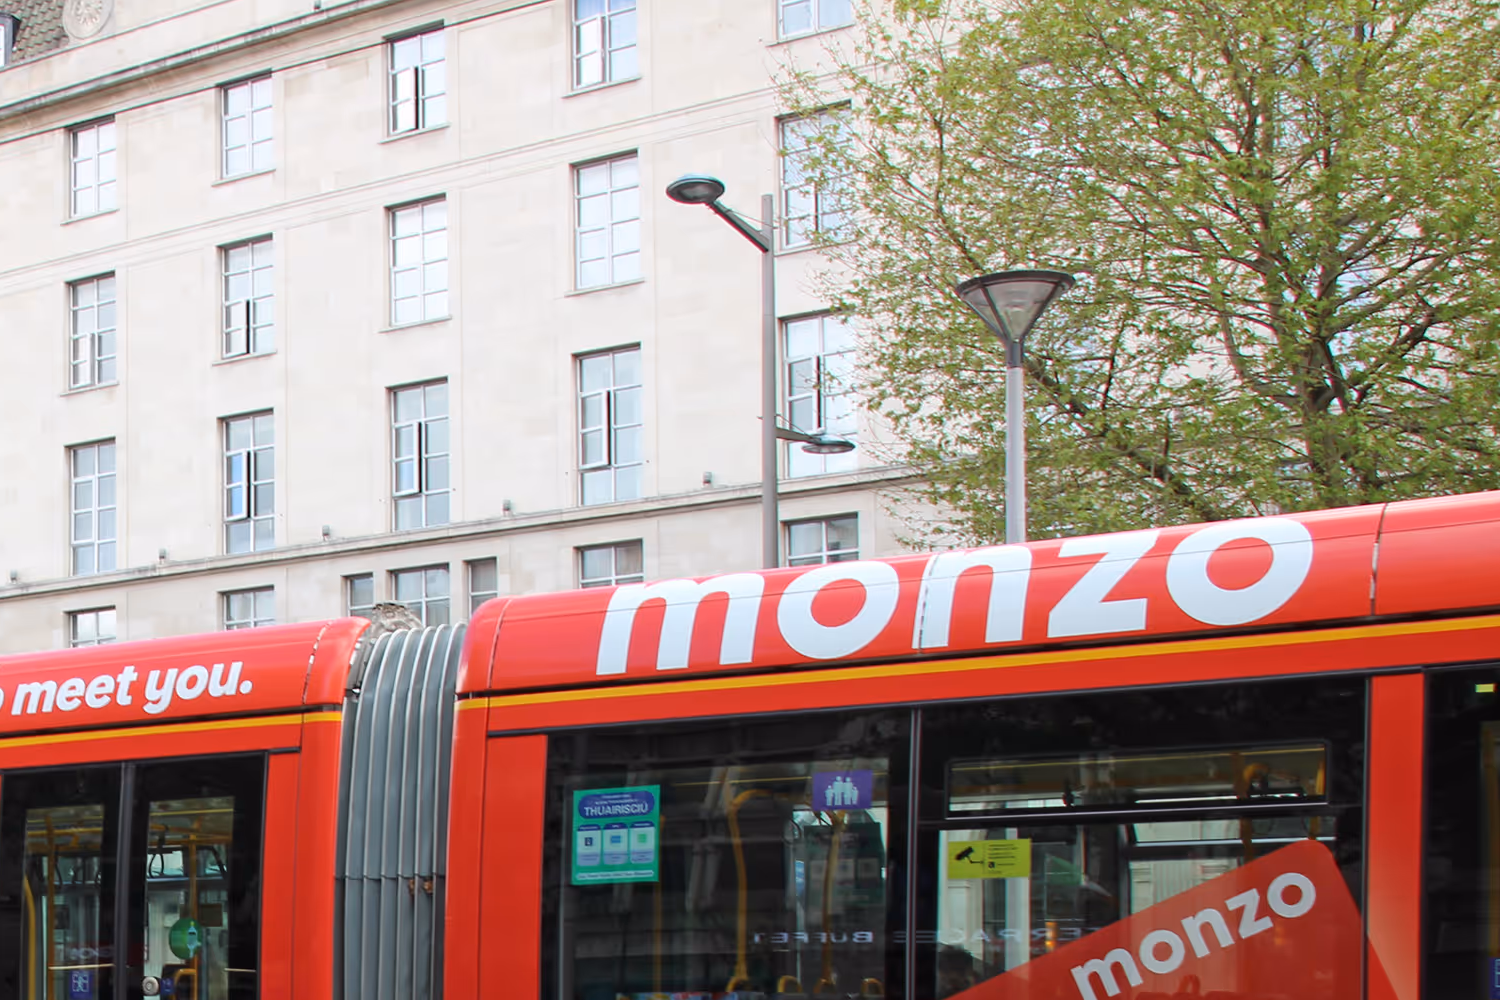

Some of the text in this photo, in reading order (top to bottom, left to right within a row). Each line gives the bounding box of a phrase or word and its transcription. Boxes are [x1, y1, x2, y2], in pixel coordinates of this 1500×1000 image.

[596, 516, 1313, 676] monzo
[11, 664, 138, 716] meet
[142, 661, 254, 715] you.
